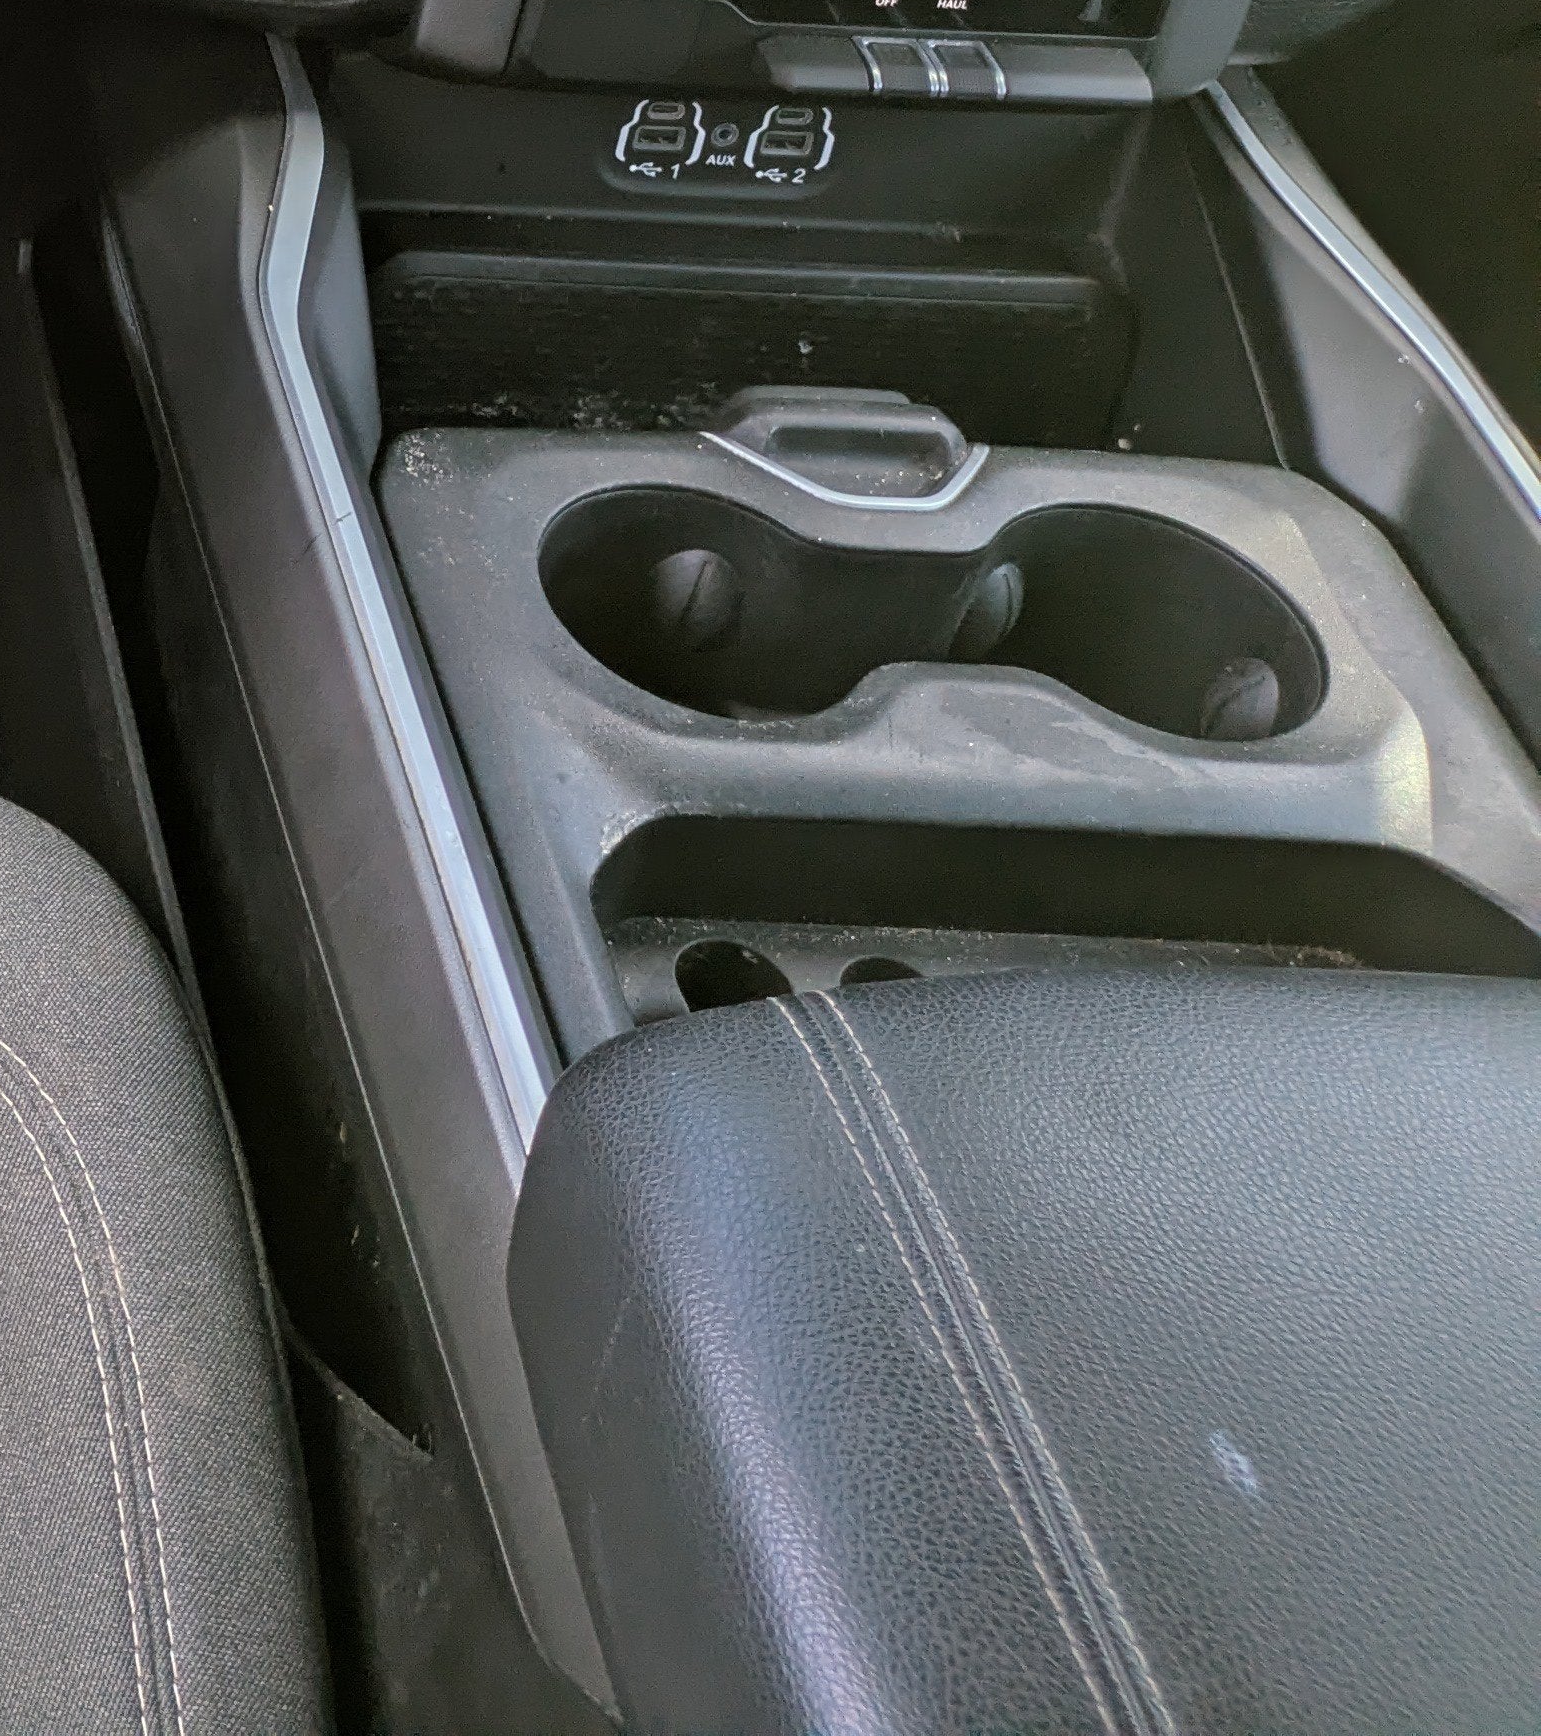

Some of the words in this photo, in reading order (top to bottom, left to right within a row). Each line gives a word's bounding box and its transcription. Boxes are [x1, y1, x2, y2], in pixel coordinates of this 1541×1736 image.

[937, 0, 968, 10] HAUL
[705, 154, 737, 166] AUX
[670, 164, 681, 180] 1
[791, 168, 806, 184] 2
